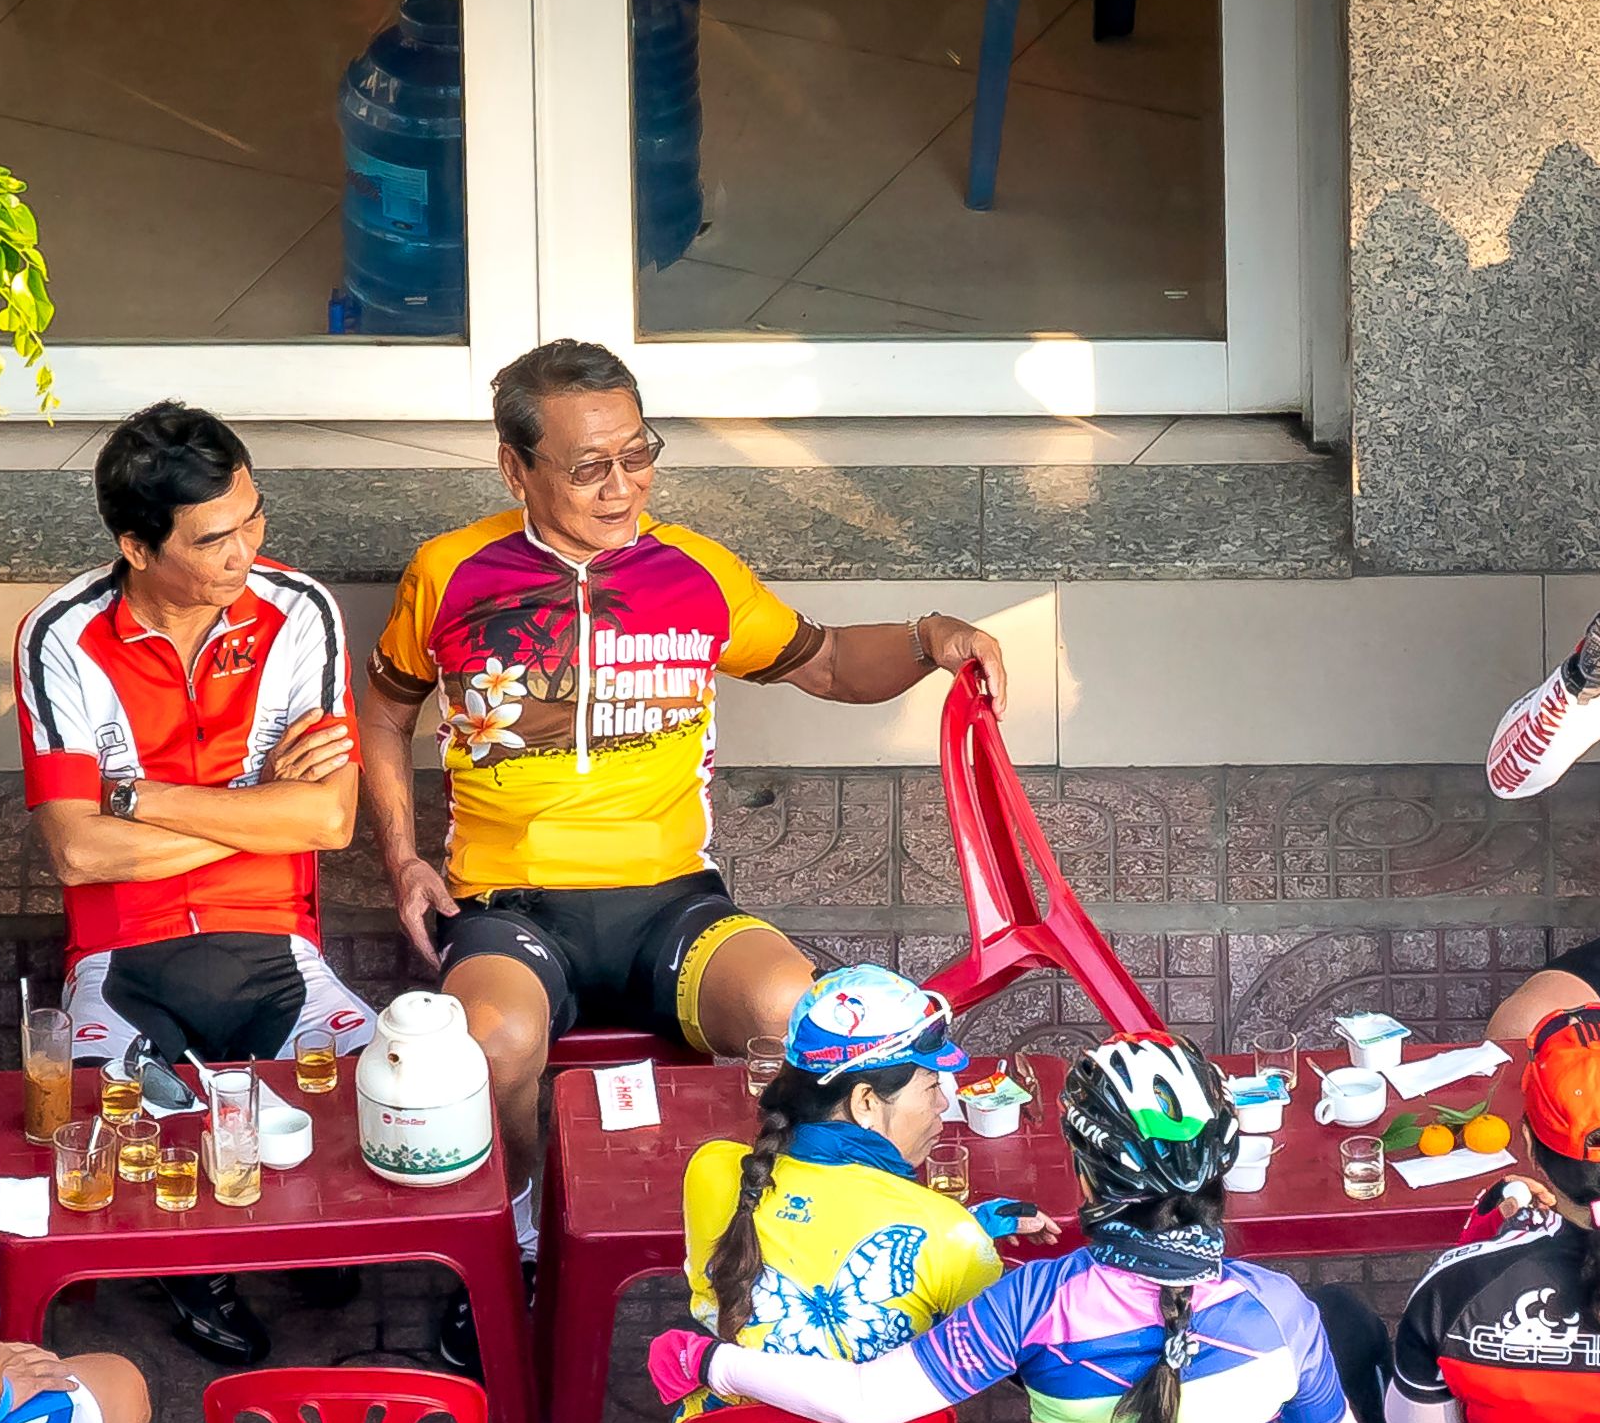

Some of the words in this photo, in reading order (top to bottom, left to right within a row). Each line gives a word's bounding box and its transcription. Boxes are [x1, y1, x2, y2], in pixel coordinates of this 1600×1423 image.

[211, 643, 257, 673] VK
[595, 627, 715, 666] Honolulu
[595, 663, 708, 702] Century
[592, 701, 663, 737] Ride
